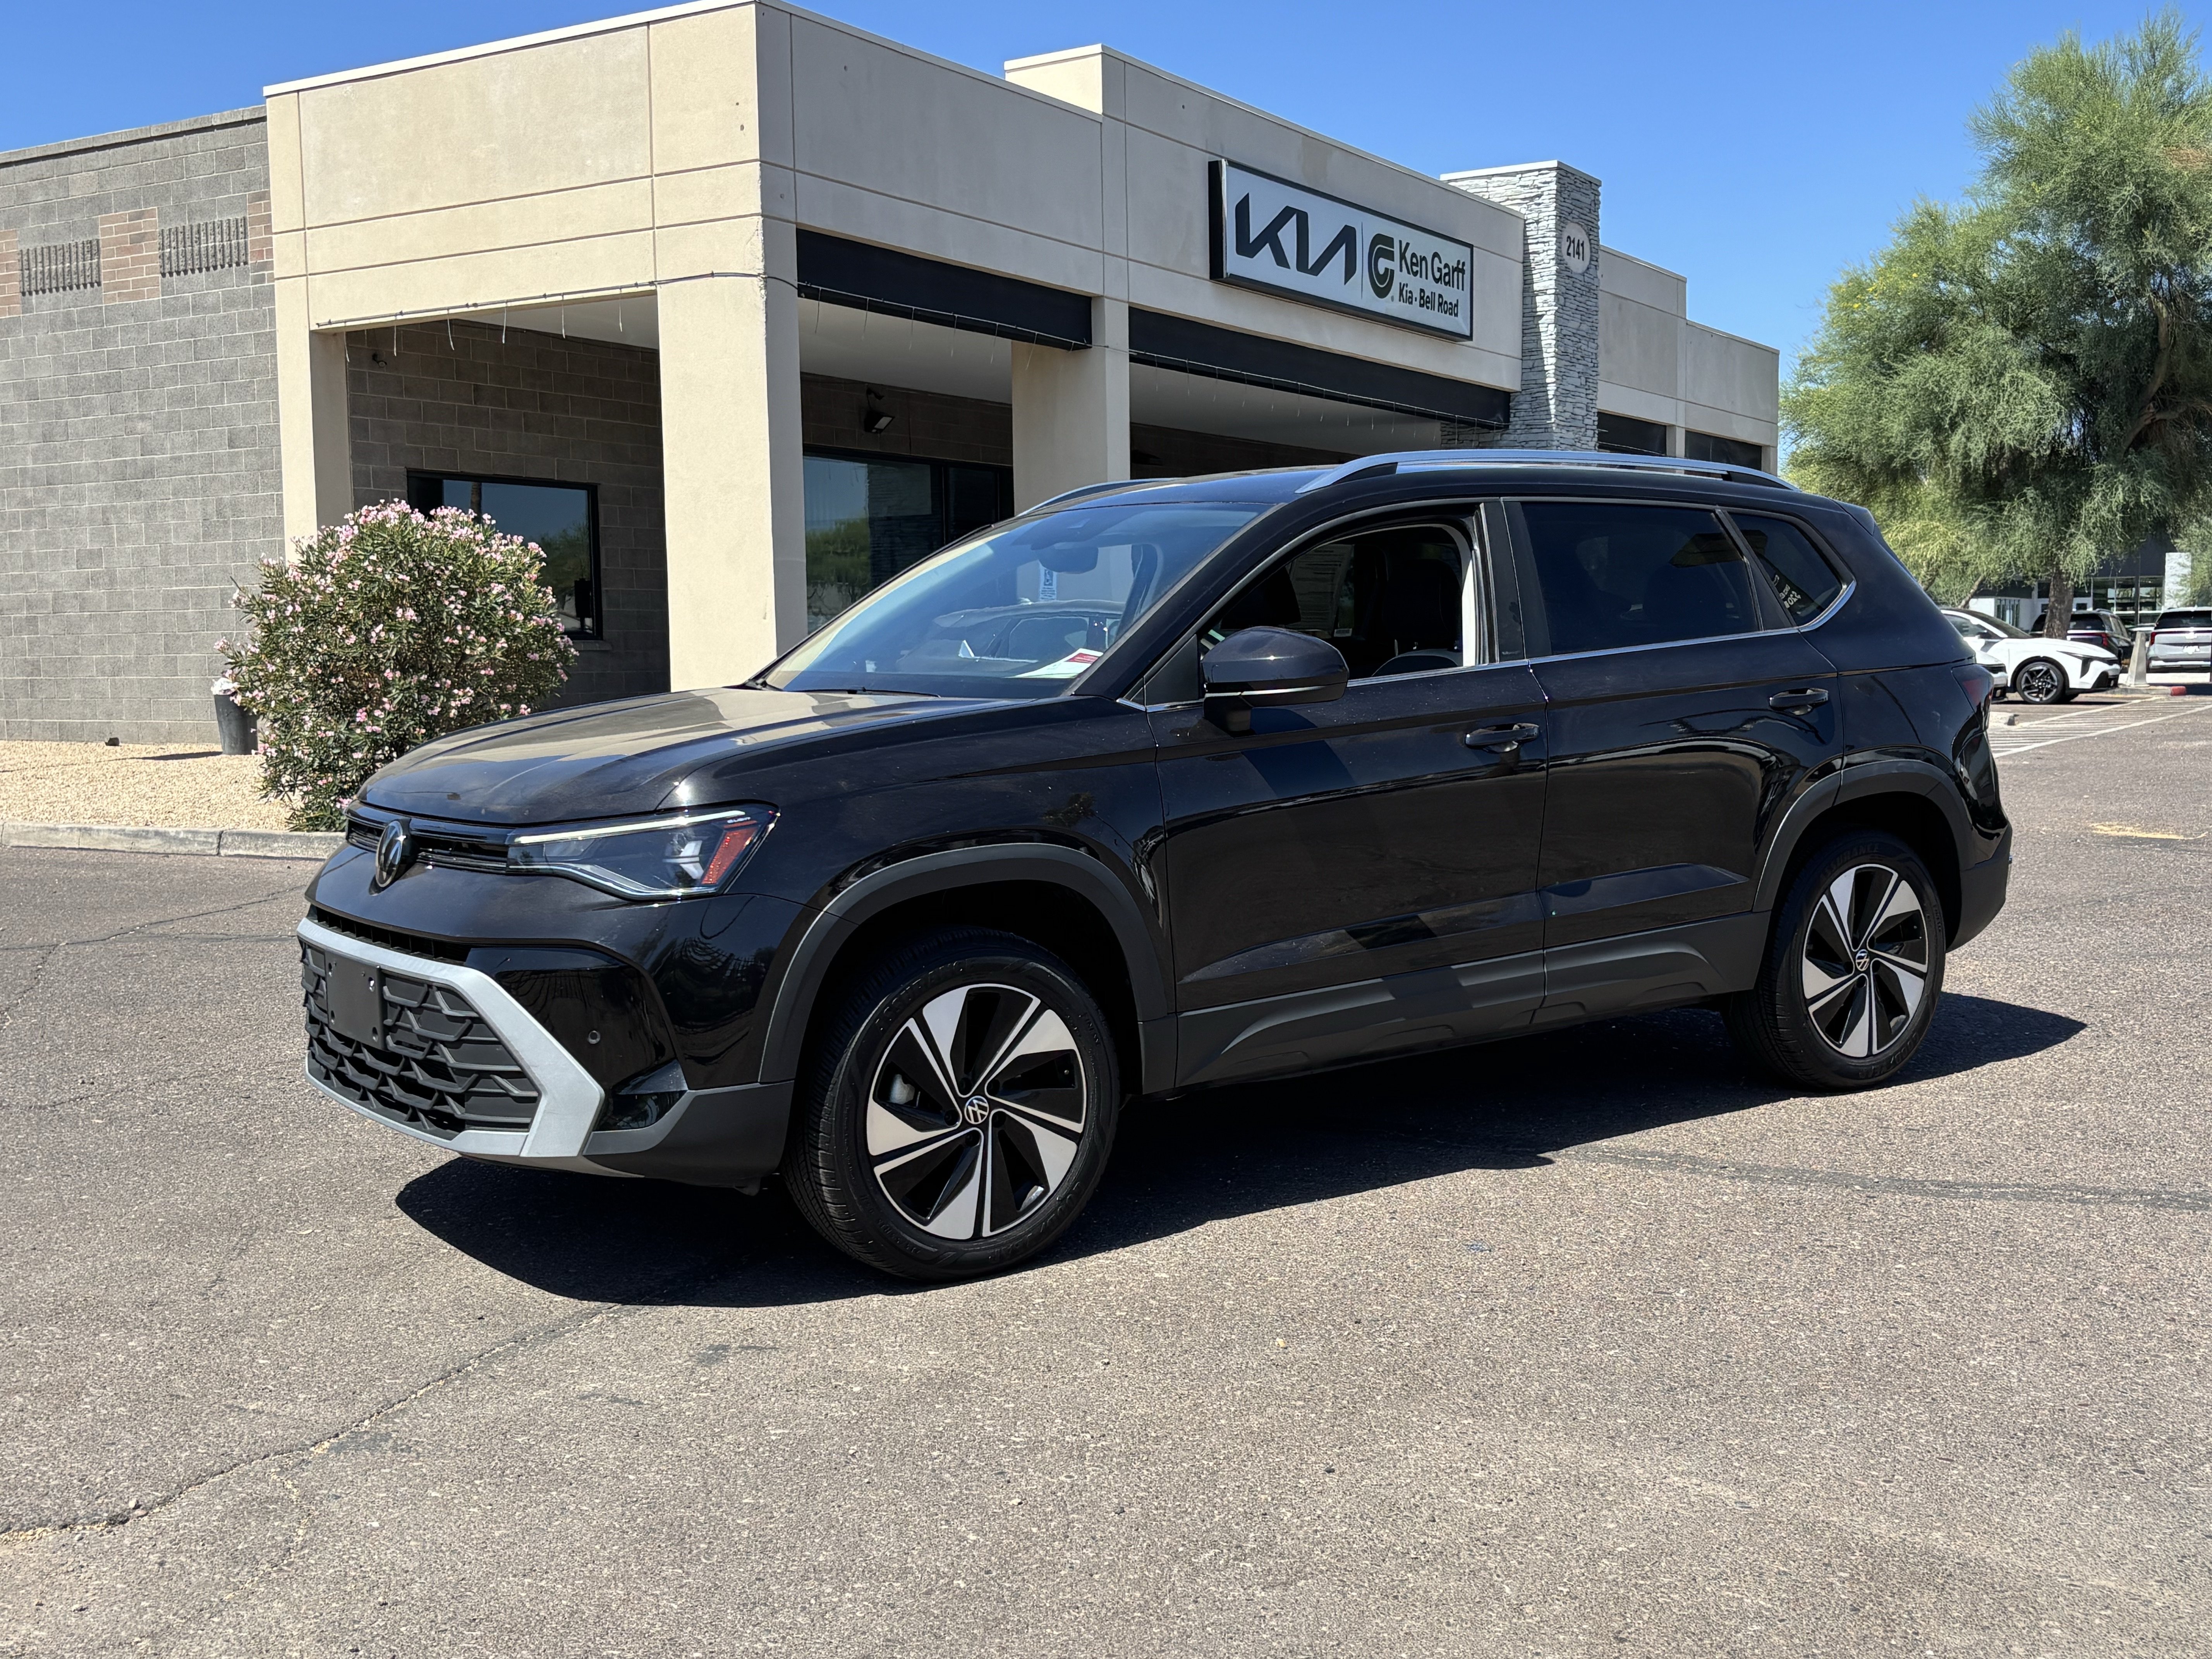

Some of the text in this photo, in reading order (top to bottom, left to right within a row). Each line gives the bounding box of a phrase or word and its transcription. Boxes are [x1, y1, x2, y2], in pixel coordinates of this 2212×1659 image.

[1235, 192, 1357, 285] KIA
[1566, 235, 1584, 261] 2141
[1399, 239, 1466, 291] Ken Garff
[1399, 282, 1459, 318] Kia Bell Road
